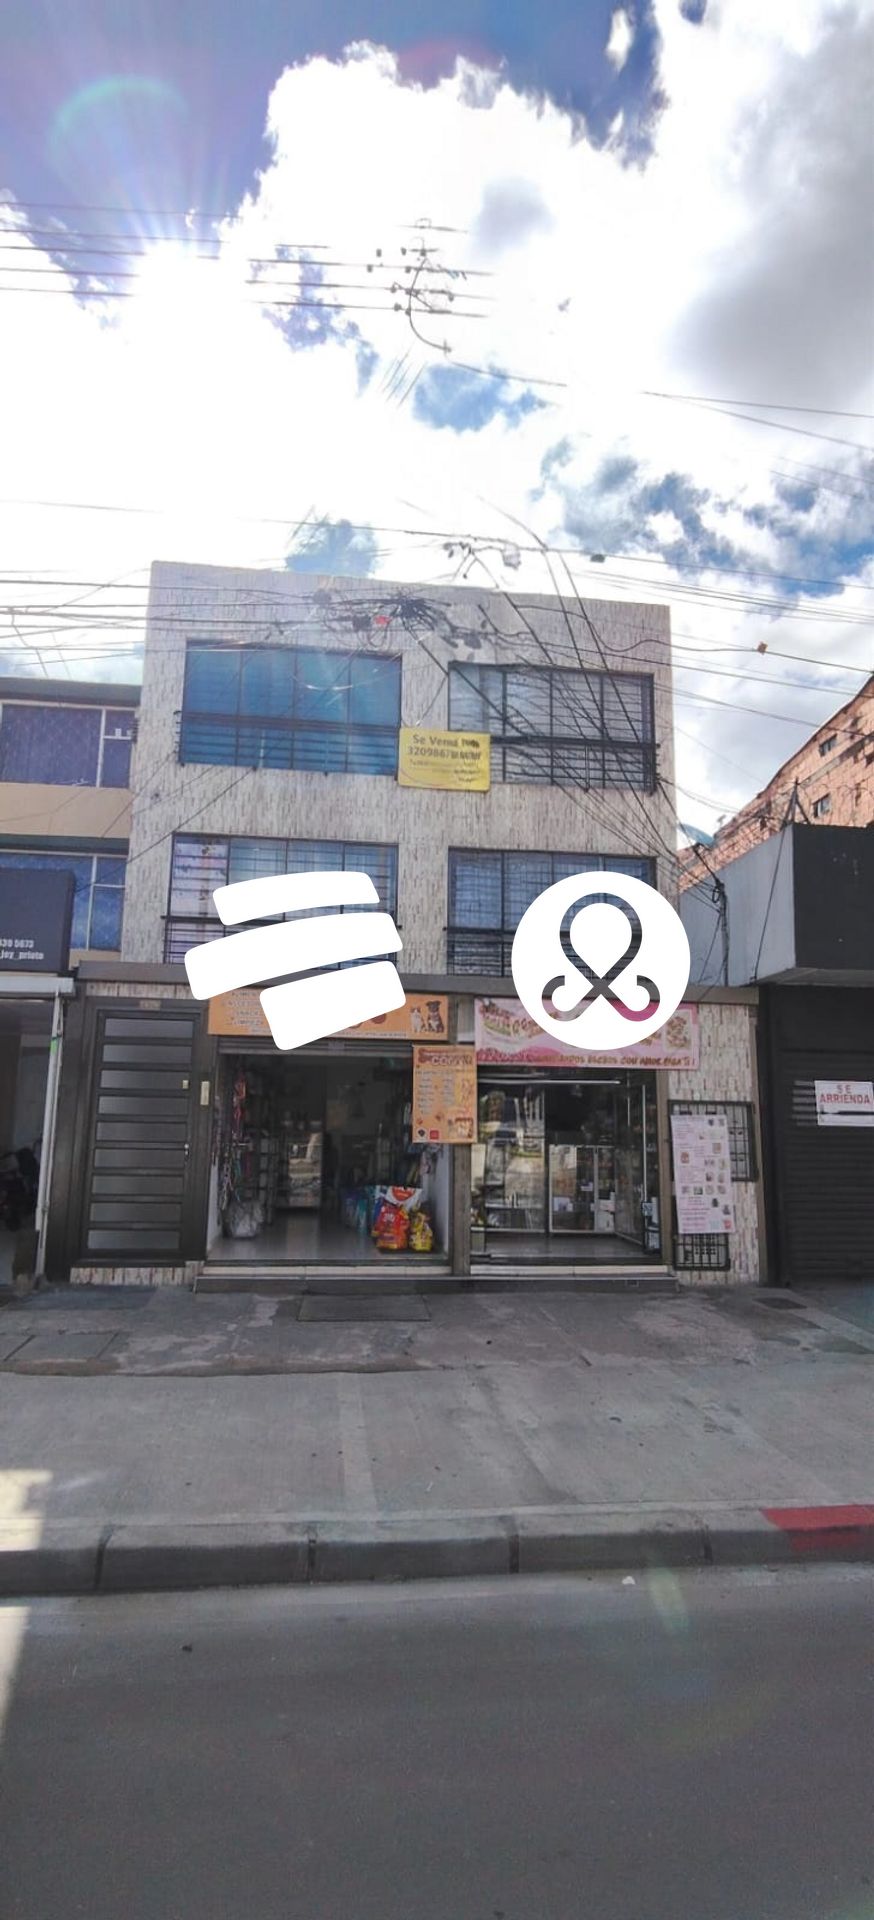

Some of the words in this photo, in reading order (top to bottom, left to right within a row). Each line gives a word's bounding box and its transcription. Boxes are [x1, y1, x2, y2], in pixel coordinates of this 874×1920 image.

[413, 734, 426, 745] Se
[836, 1084, 852, 1094] SE
[820, 1094, 871, 1105] ARRIENDA
